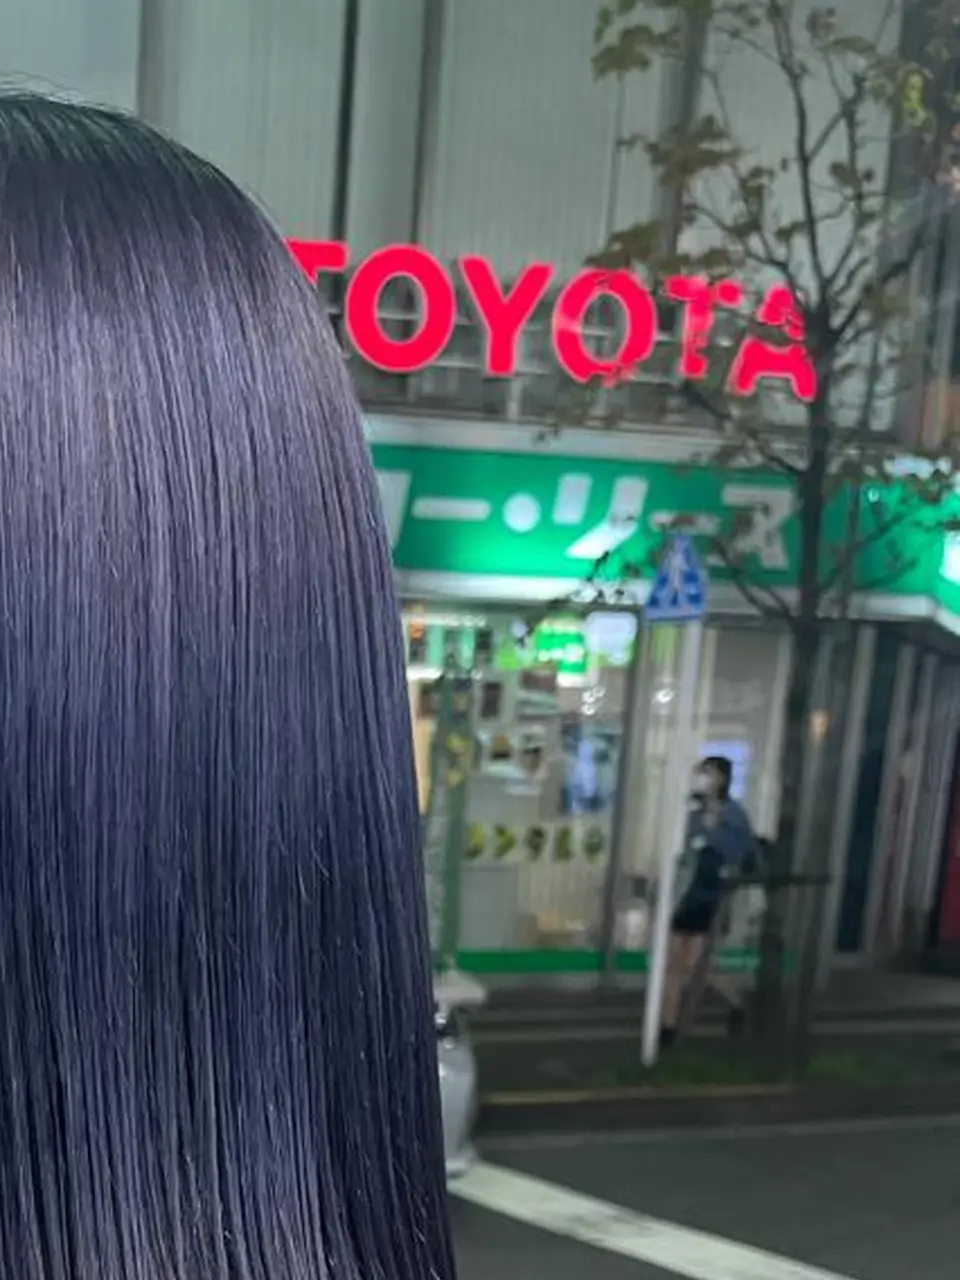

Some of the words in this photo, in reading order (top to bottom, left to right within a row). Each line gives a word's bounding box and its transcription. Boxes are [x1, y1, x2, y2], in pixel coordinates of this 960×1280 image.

[375, 468, 794, 569] ー・リース
